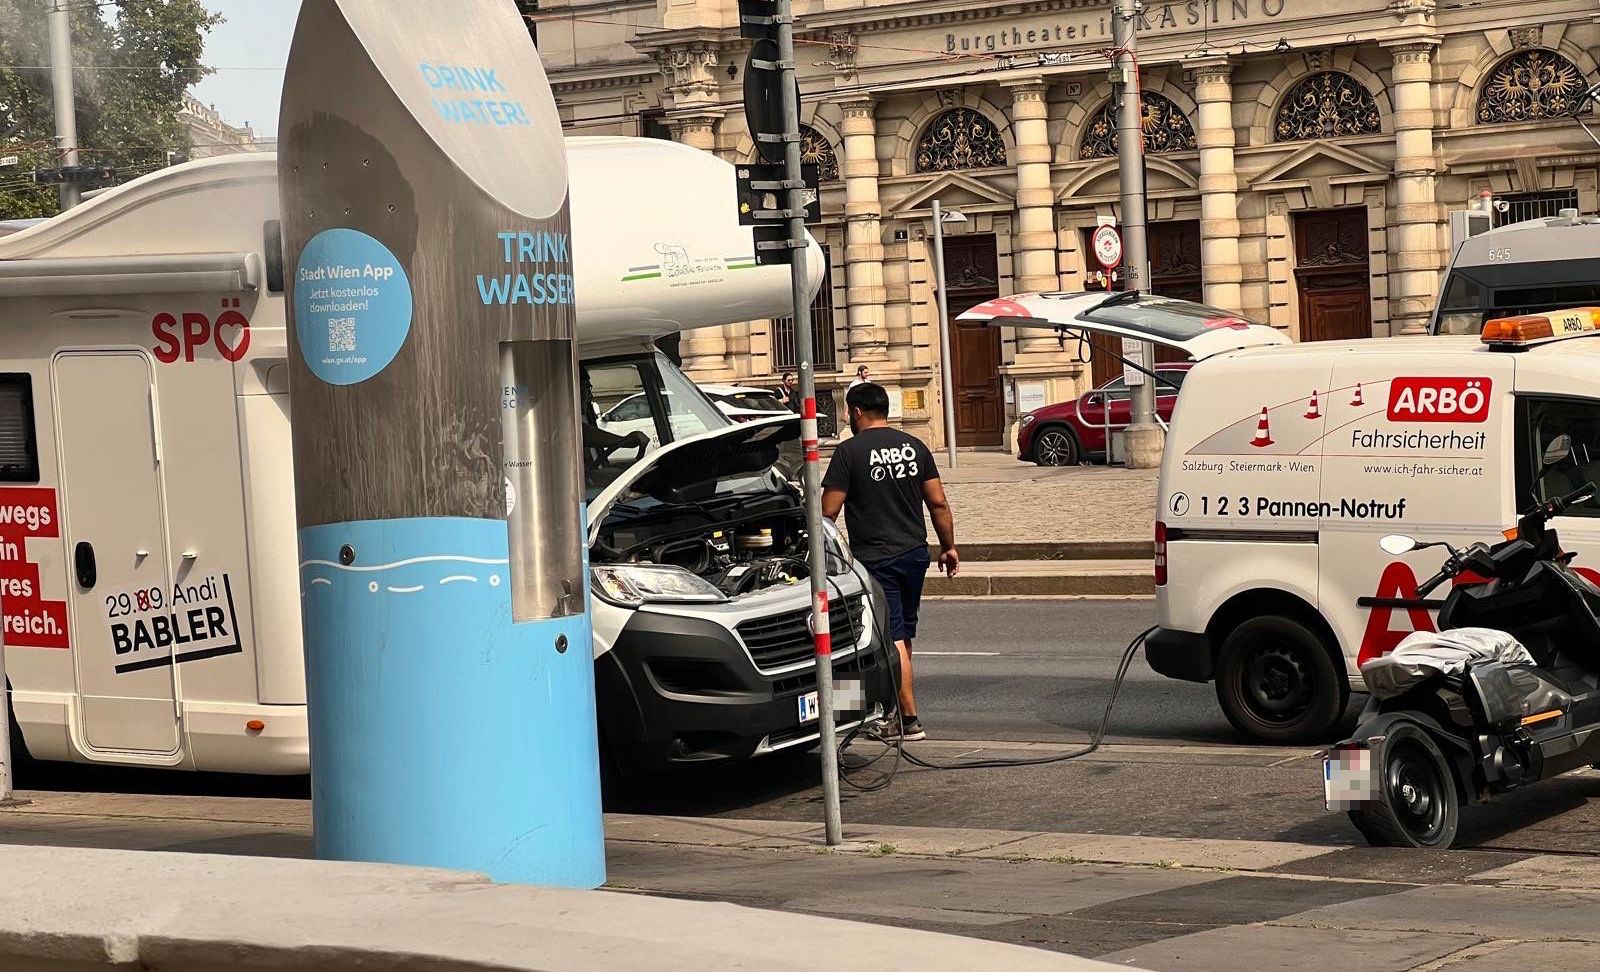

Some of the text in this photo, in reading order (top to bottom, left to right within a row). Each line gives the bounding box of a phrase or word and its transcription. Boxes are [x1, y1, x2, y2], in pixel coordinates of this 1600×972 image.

[1136, 0, 1286, 30] KASINO
[945, 24, 1088, 51] Burgtheater
[418, 62, 507, 93] DRINK
[431, 97, 530, 126] WATER!
[497, 232, 569, 263] TRINK
[1489, 249, 1511, 260] 645
[300, 264, 393, 281] Stadt Wien App
[309, 285, 379, 300] Jetzt kostenlos
[476, 274, 575, 305] WASSER
[309, 299, 369, 313] downloaden!
[152, 298, 250, 364] SPÖ
[1563, 314, 1583, 331] ARBÖ
[1393, 381, 1485, 415] ARBÖ
[1352, 430, 1486, 450] Fahrsicherheit
[870, 443, 916, 465] ARBÖ
[895, 463, 907, 479] 2
[909, 461, 918, 476] 3
[1182, 460, 1315, 475] Salzburg Steiermark Wien
[1363, 464, 1483, 477] www.ich-fahr-sicher.at
[1200, 496, 1406, 519] 1 2 3 Pannen-Notruf
[1, 578, 33, 597] res
[171, 576, 218, 607] Andi
[4, 609, 63, 636] reich.
[111, 605, 229, 655] BABLER
[808, 697, 816, 715] W
